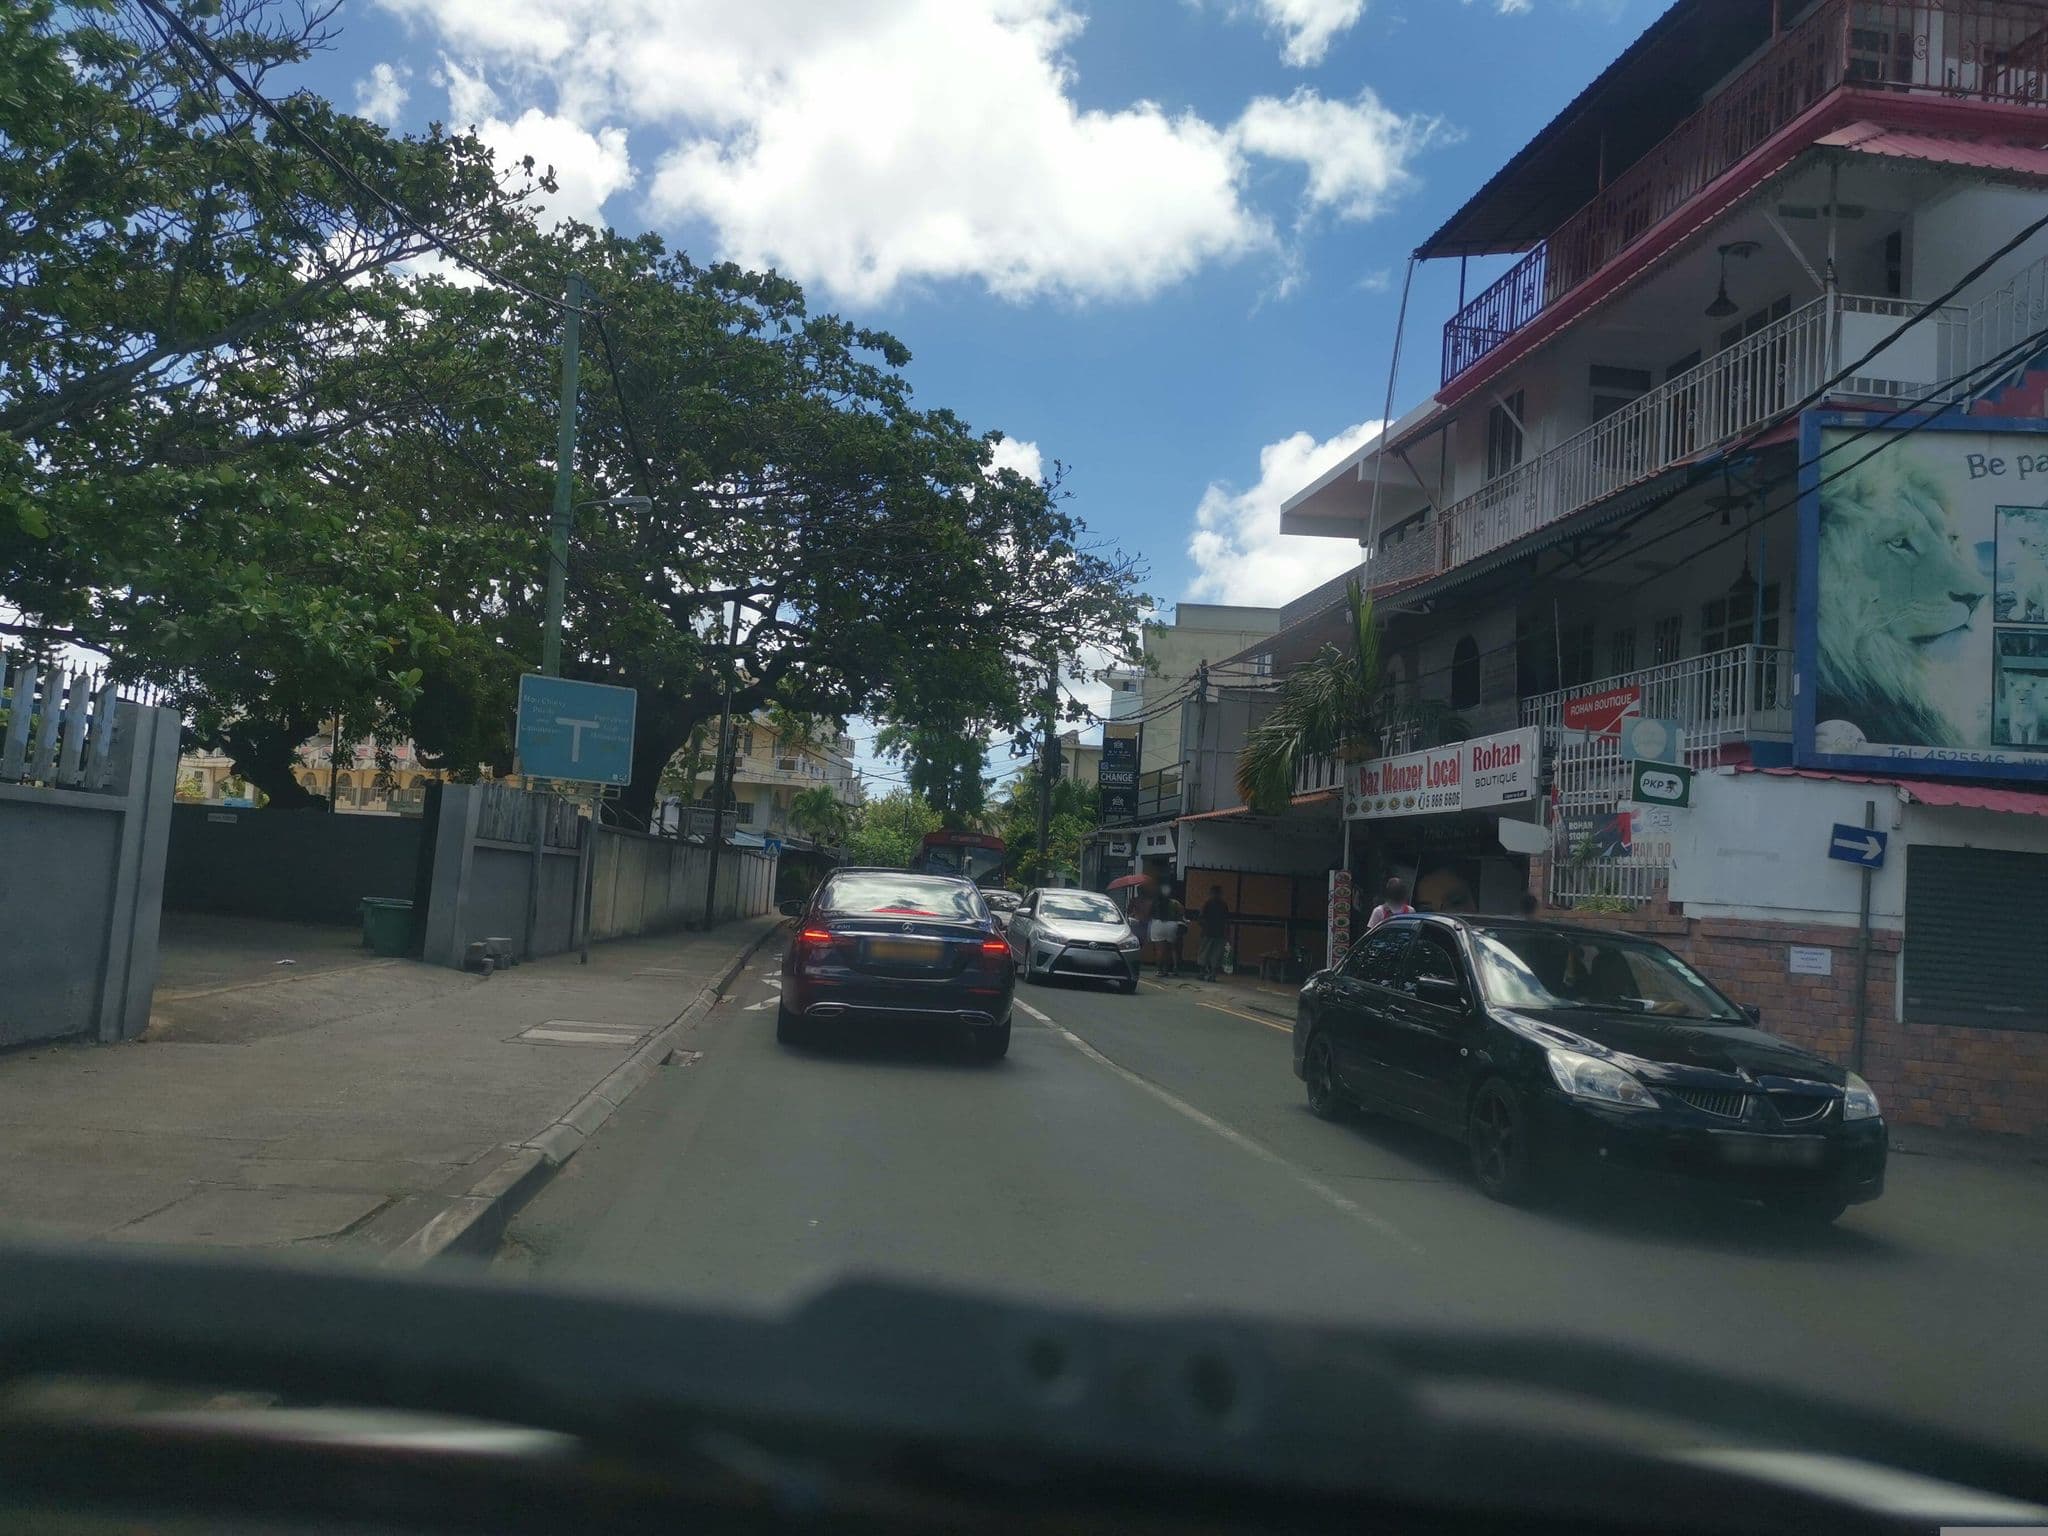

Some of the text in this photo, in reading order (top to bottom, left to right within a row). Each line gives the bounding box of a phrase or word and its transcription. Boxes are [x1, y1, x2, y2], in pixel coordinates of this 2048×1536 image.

[1966, 454, 2007, 480] Be
[1570, 693, 1633, 717] ROHAN BOUTIQUE
[1473, 743, 1521, 772] Rohan
[1100, 772, 1134, 782] CHANGE
[1359, 750, 1462, 797] Baz Manzer Local
[1475, 772, 1518, 788] BOUTIQUE
[1642, 778, 1664, 789] PKP
[1568, 821, 1593, 830] ROHAN
